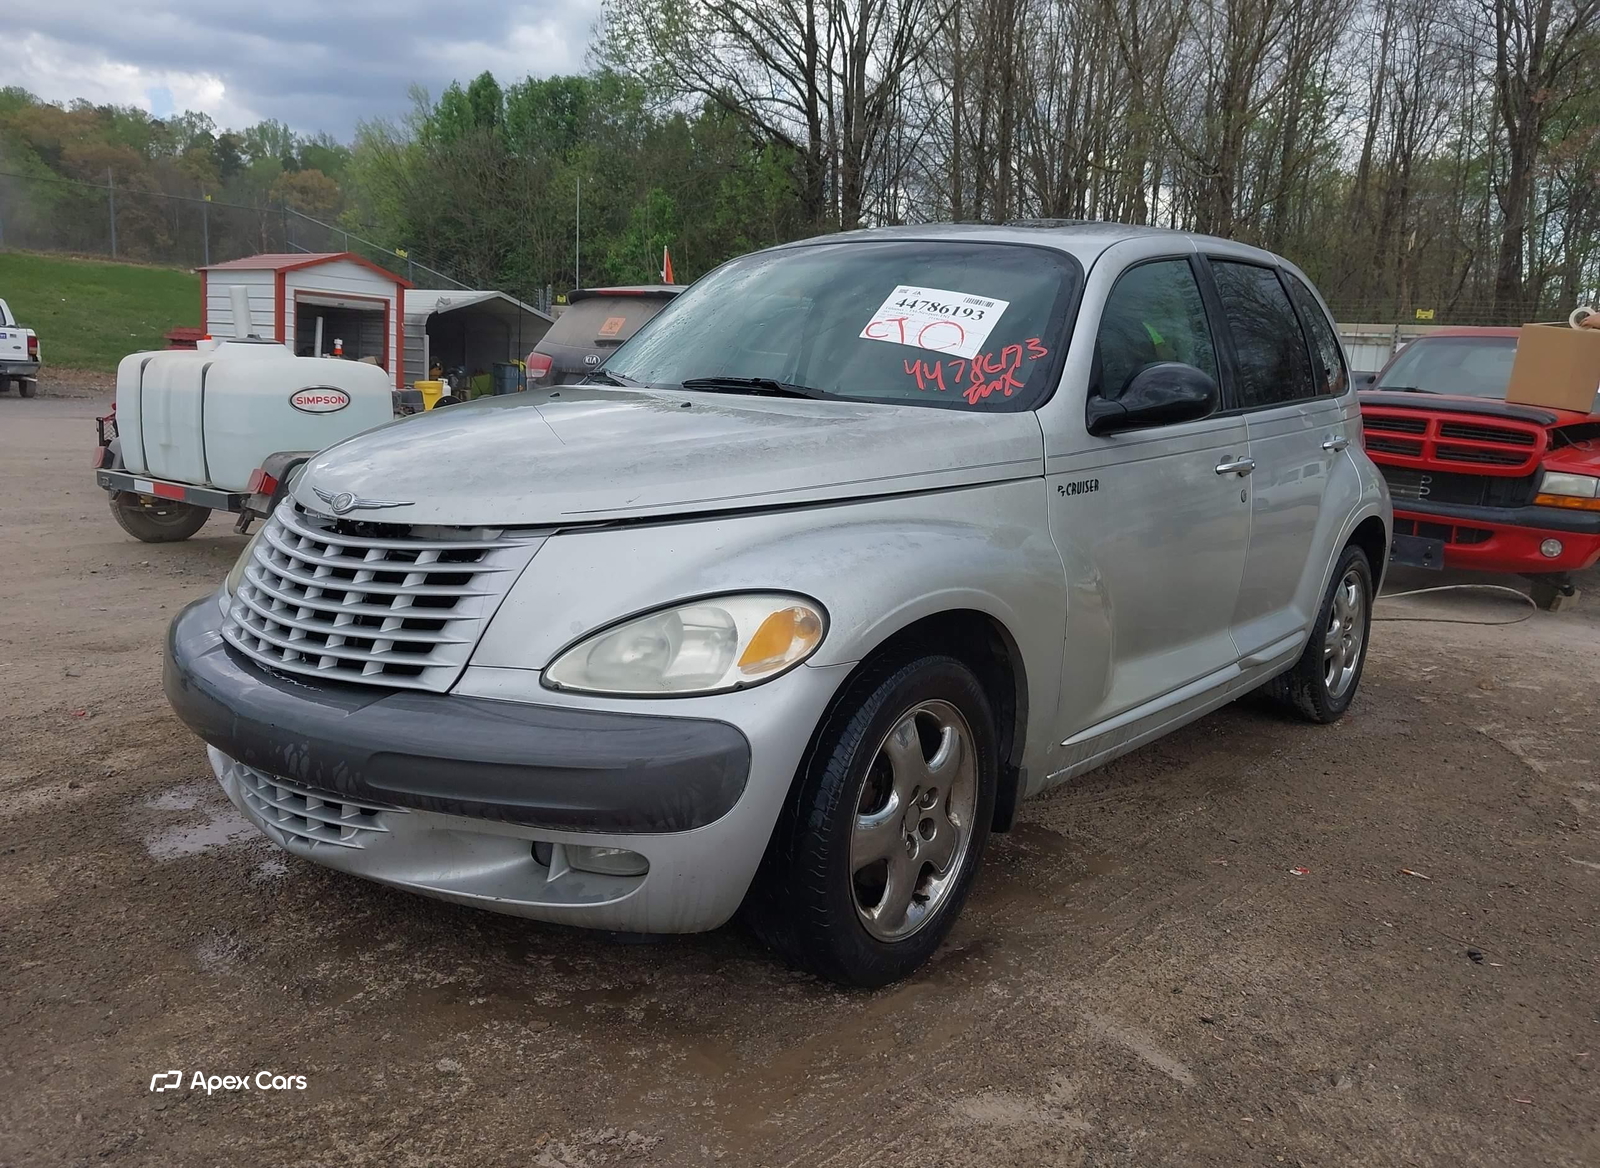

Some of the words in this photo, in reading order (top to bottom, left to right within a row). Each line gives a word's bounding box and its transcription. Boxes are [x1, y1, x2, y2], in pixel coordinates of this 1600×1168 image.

[895, 297, 986, 321] 44786193
[584, 355, 597, 364] KIA
[296, 396, 345, 405] SIMPSON
[1057, 485, 1066, 497] PT
[1066, 479, 1100, 496] CRUISER
